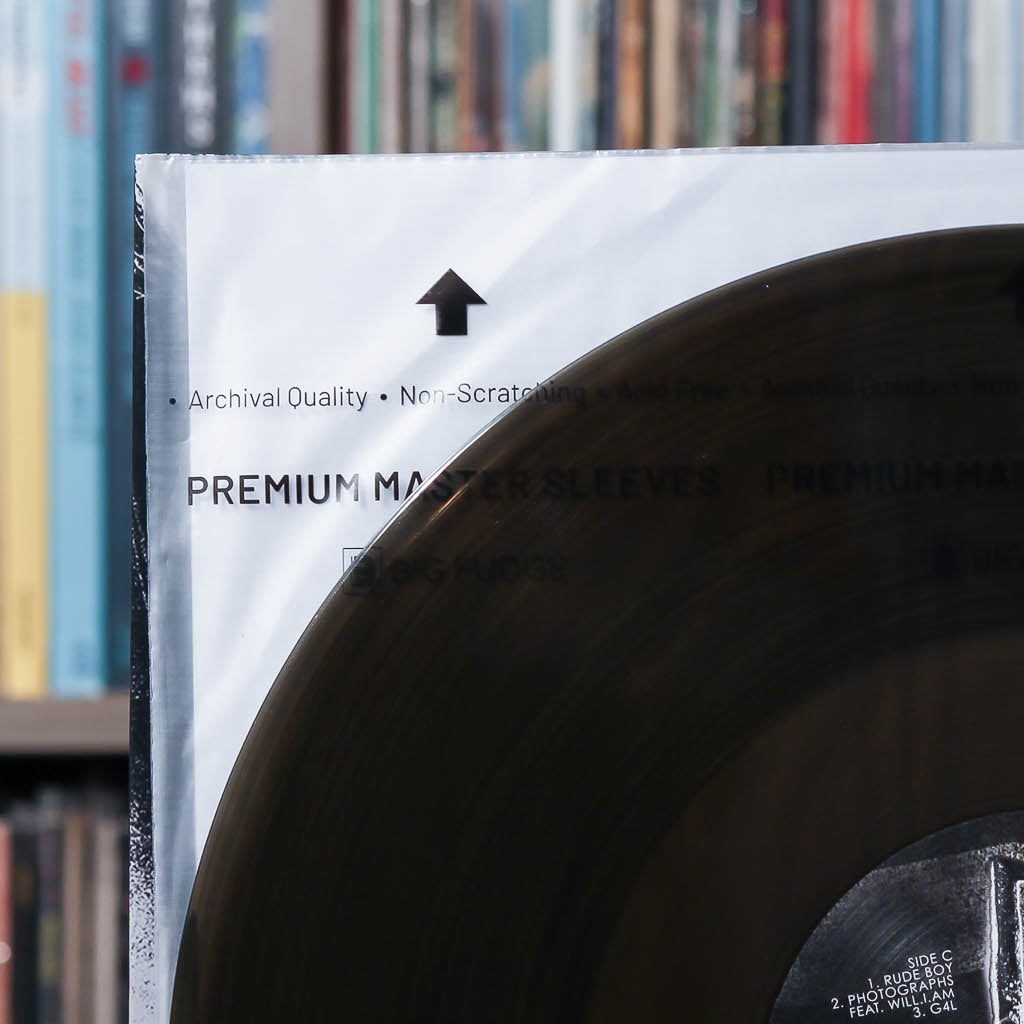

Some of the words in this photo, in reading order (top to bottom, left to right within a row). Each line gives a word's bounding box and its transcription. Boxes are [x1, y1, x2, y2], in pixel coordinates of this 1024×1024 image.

[189, 387, 281, 410] Archival
[287, 385, 368, 412] Quality
[400, 379, 586, 409] Non-Scratching
[187, 471, 361, 506] PREMIUM
[374, 467, 530, 503] MASTER
[543, 464, 721, 500] SLEEVES
[908, 952, 938, 969] SIDE
[941, 949, 953, 961] C
[868, 978, 880, 989] 1.
[883, 968, 920, 986] RUDE
[924, 962, 953, 978] BOY
[831, 998, 844, 1010] 2.
[847, 974, 954, 1006] PHOTOGRAPHS
[849, 1002, 884, 1019] FEAT.
[887, 988, 955, 1010] WILL.I.AM
[913, 1006, 926, 1018] 3.
[930, 1000, 958, 1014] G4L
